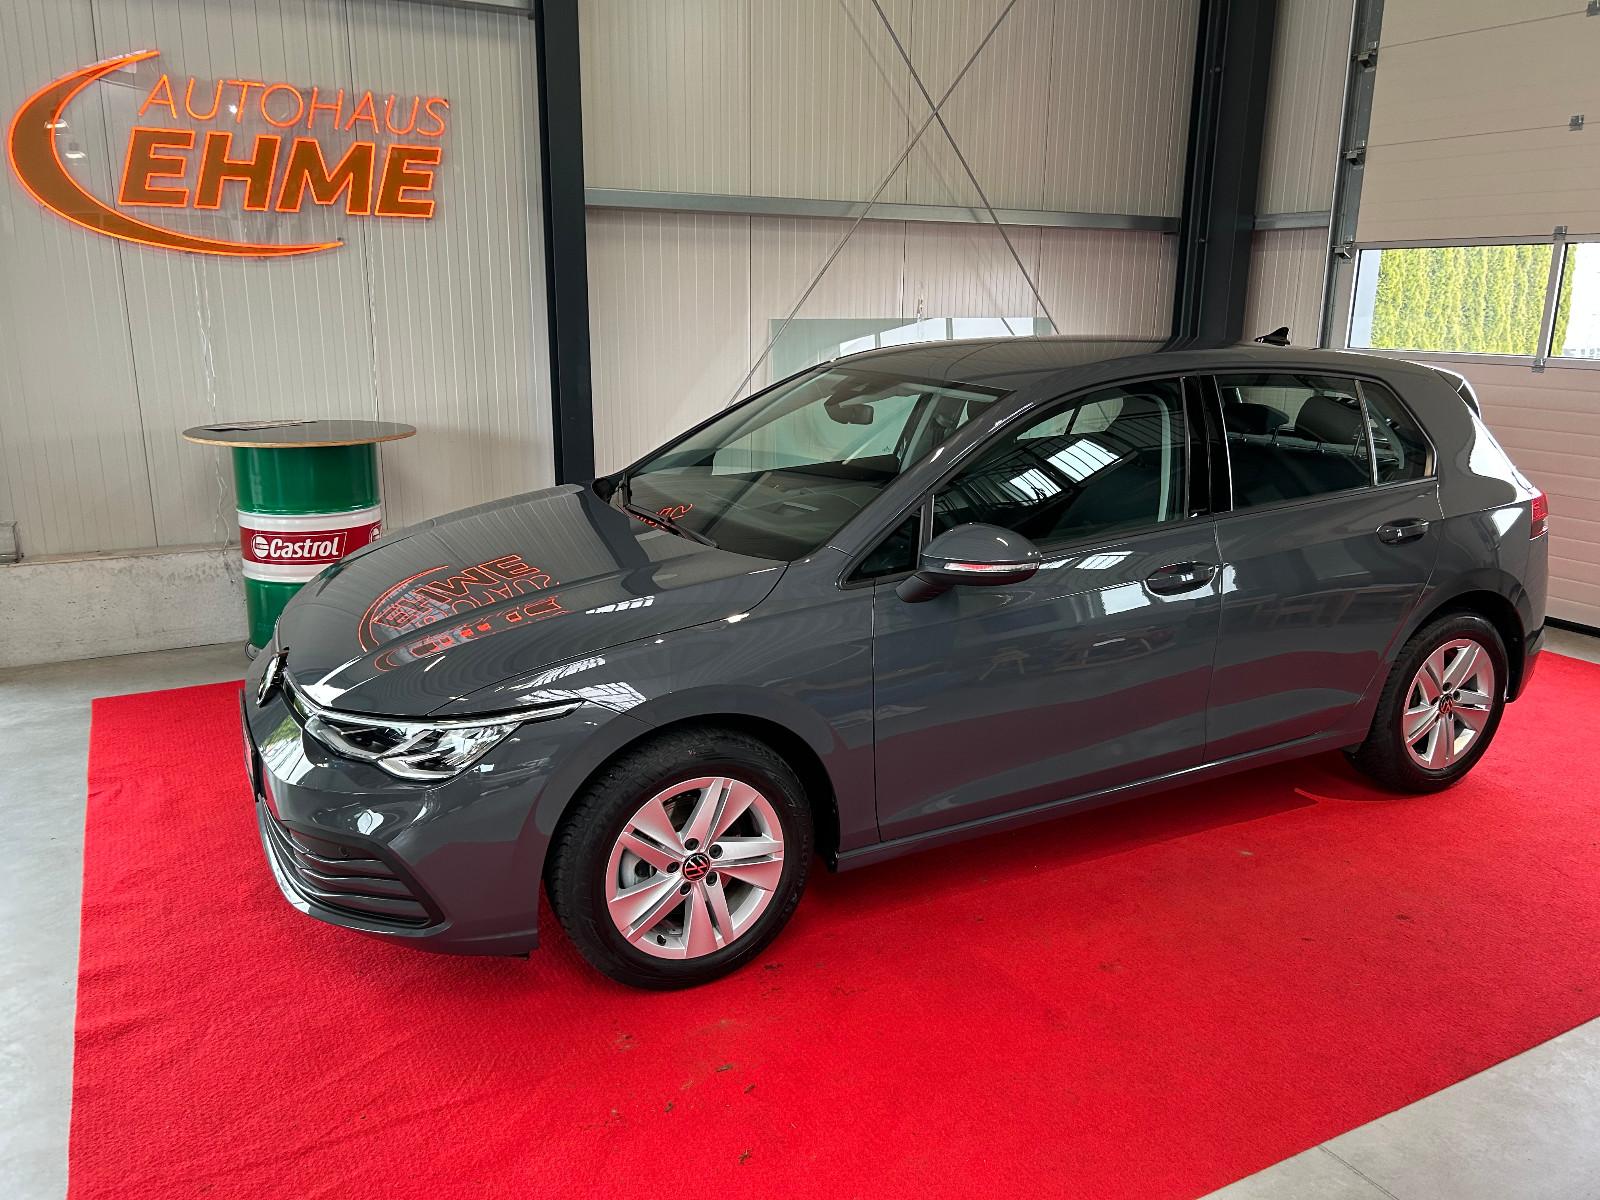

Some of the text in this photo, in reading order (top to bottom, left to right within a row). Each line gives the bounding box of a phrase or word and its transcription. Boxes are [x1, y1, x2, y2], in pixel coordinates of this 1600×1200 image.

[138, 74, 449, 136] AUTOHAUS
[118, 127, 442, 217] EHME
[269, 537, 339, 558] Castrol
